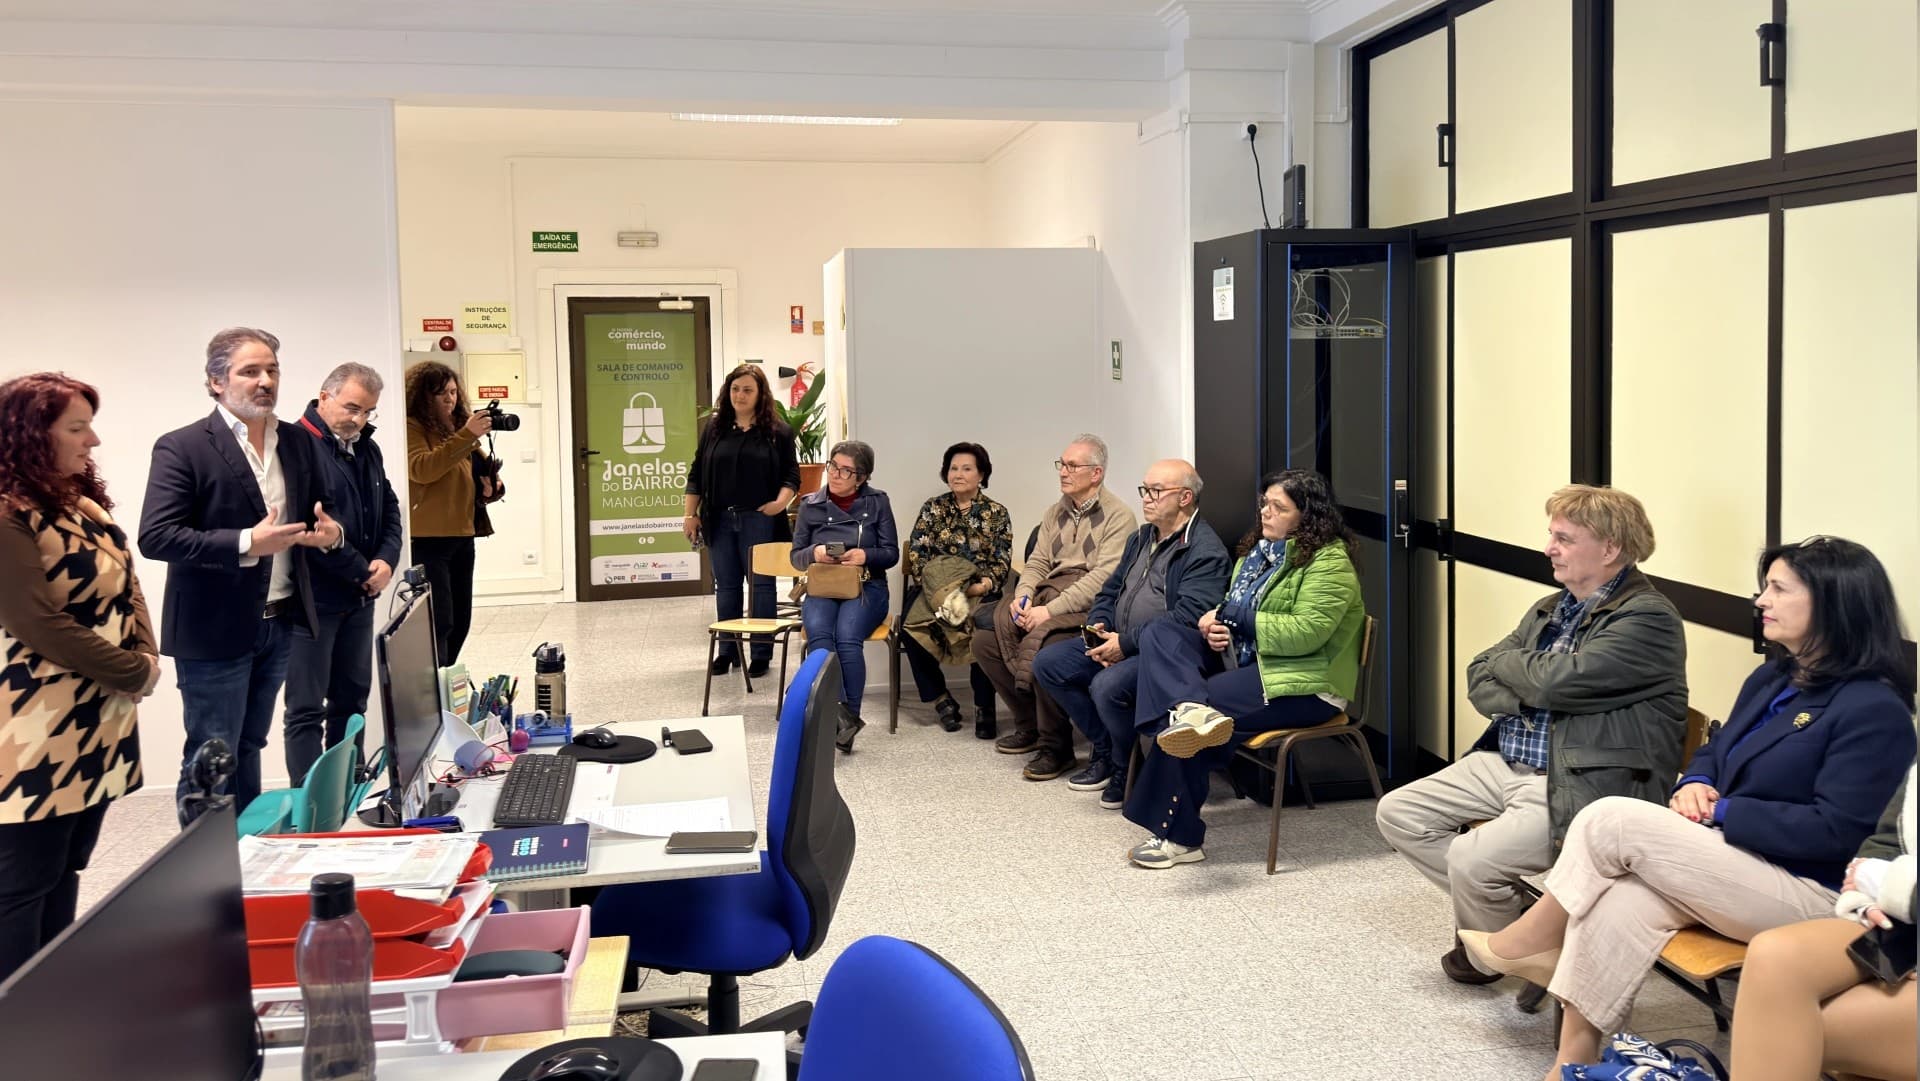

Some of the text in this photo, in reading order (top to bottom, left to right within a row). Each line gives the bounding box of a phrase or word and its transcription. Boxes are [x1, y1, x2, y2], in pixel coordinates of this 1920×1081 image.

[608, 329, 665, 340] comércio,
[626, 340, 666, 350] mundo
[597, 363, 684, 372] SALA DE COMANDO
[621, 373, 670, 381] CONTROLO
[602, 475, 688, 492] DO BAIRRO
